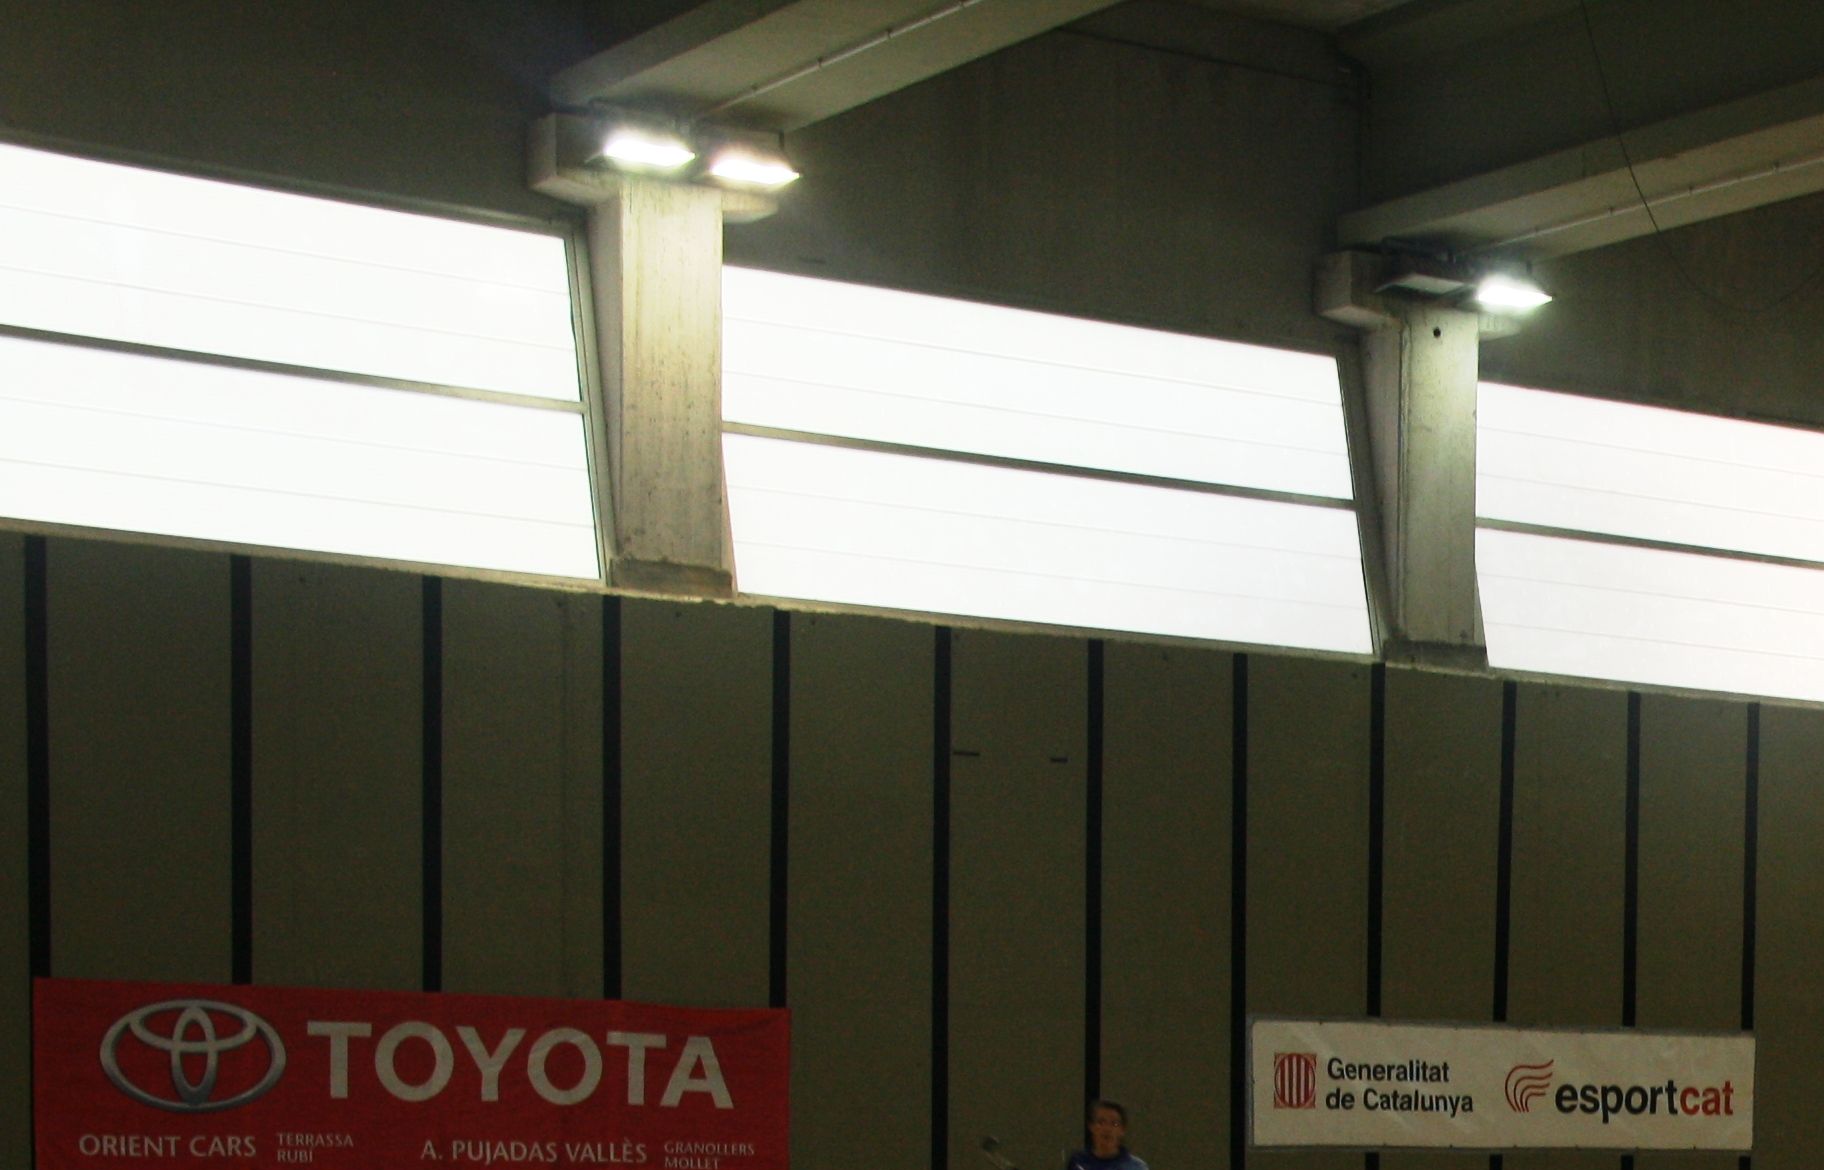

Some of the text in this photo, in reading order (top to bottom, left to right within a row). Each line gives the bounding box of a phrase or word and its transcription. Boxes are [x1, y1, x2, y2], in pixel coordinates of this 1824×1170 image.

[307, 1019, 734, 1110] TOYOTA
[1327, 1058, 1450, 1083] Generalitat
[1326, 1086, 1474, 1118] de Catalunya
[1554, 1080, 1734, 1123] esportcat
[79, 1133, 257, 1159] ORIENT CARS
[276, 1132, 355, 1148] TERRASSA
[421, 1136, 648, 1166] A. PUJADAS VALLÈS
[663, 1140, 755, 1157] GRANOLLERS
[663, 1156, 720, 1170] MOLLET
